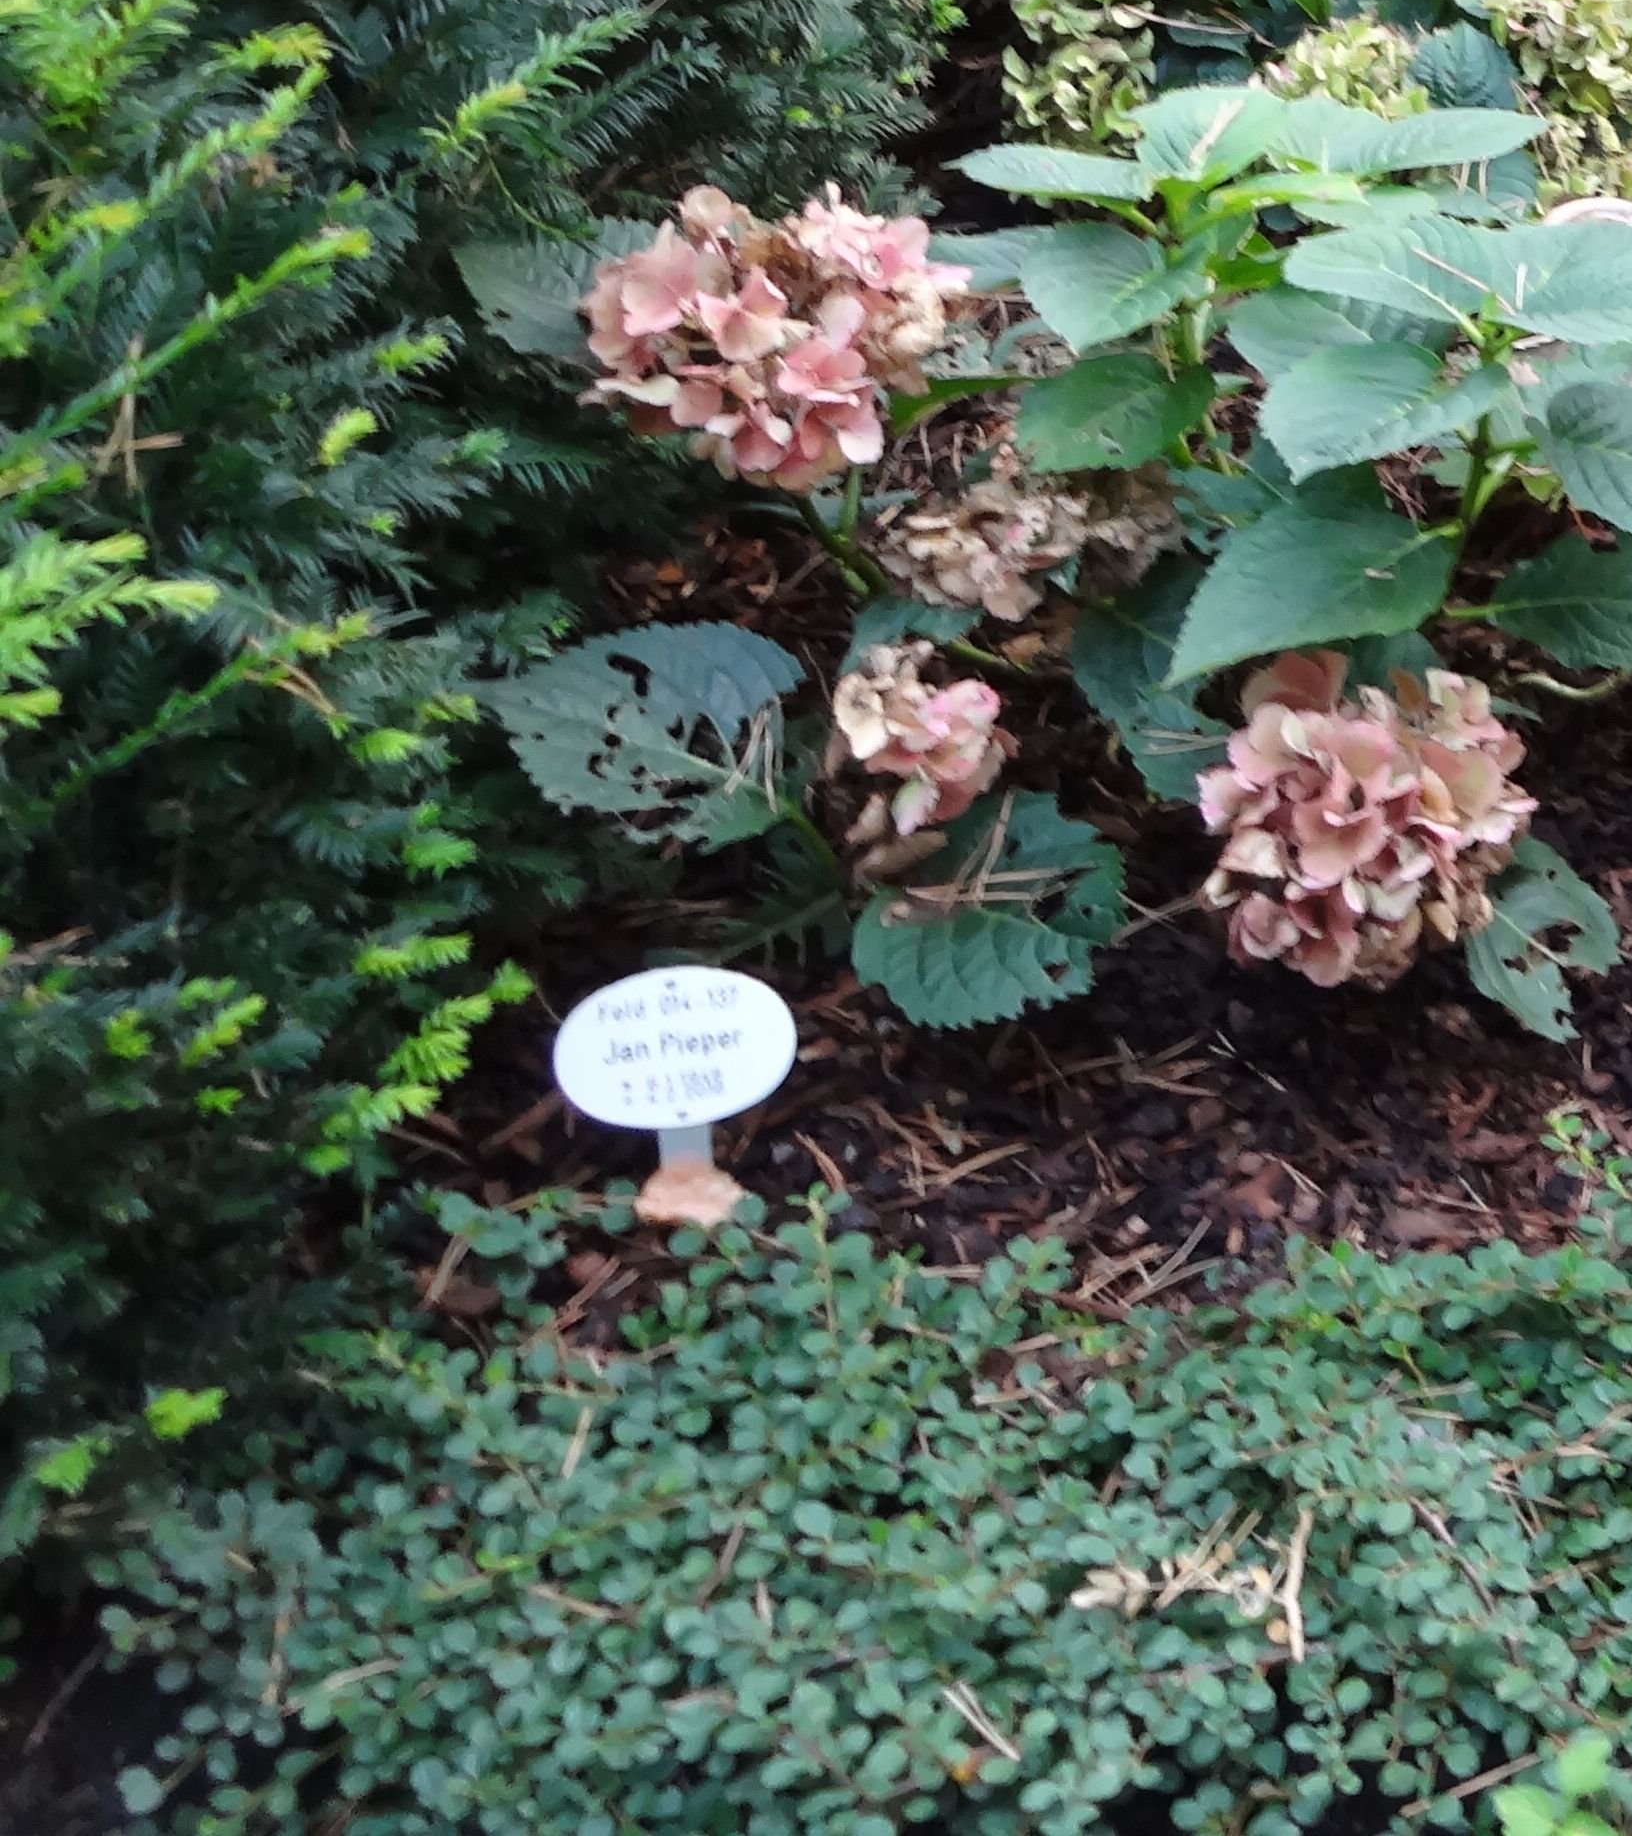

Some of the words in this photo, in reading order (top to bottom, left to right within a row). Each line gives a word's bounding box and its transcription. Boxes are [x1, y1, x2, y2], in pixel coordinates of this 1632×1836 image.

[597, 998, 649, 1023] Feld
[601, 1037, 650, 1065] Jan
[660, 1029, 742, 1057] Pieper
